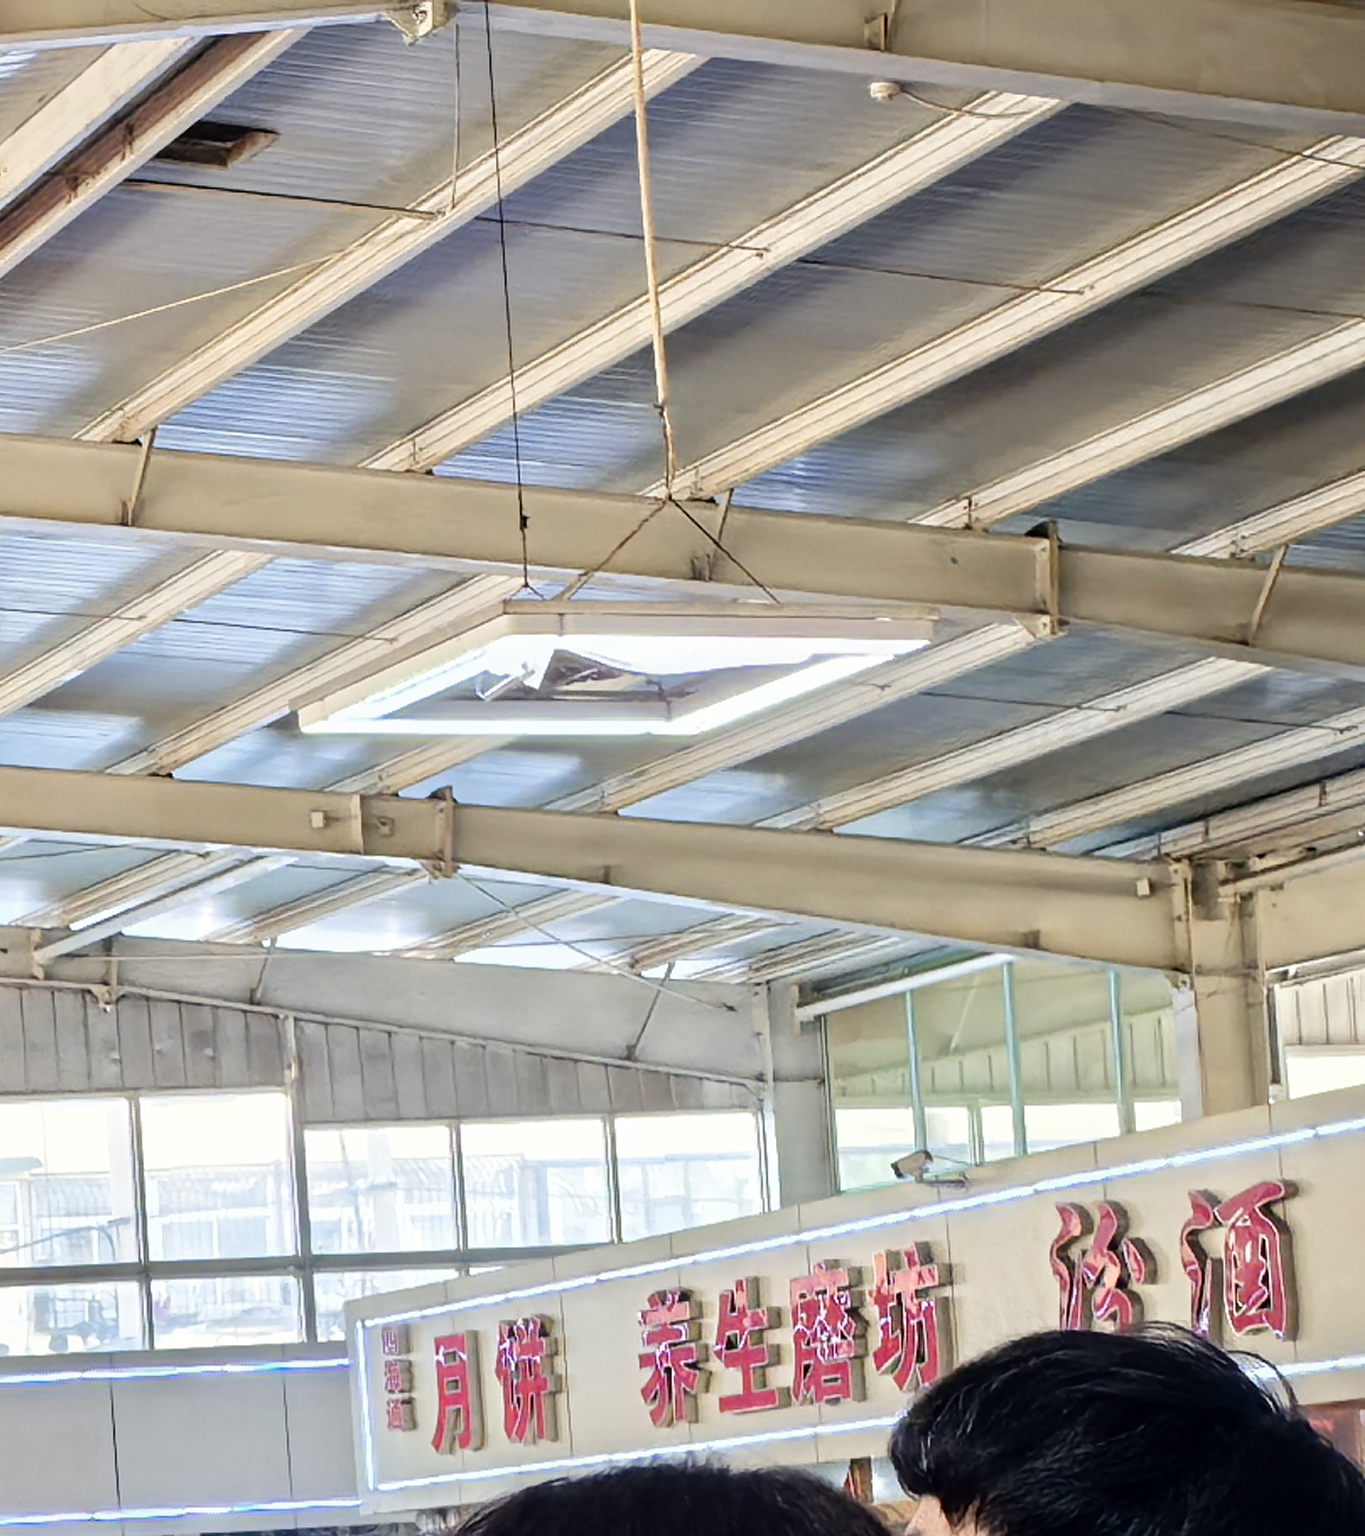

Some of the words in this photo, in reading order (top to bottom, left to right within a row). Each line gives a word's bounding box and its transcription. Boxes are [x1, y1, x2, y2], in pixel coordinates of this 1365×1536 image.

[431, 1316, 551, 1454] 月饼
[637, 1242, 941, 1428] 养生磨坊
